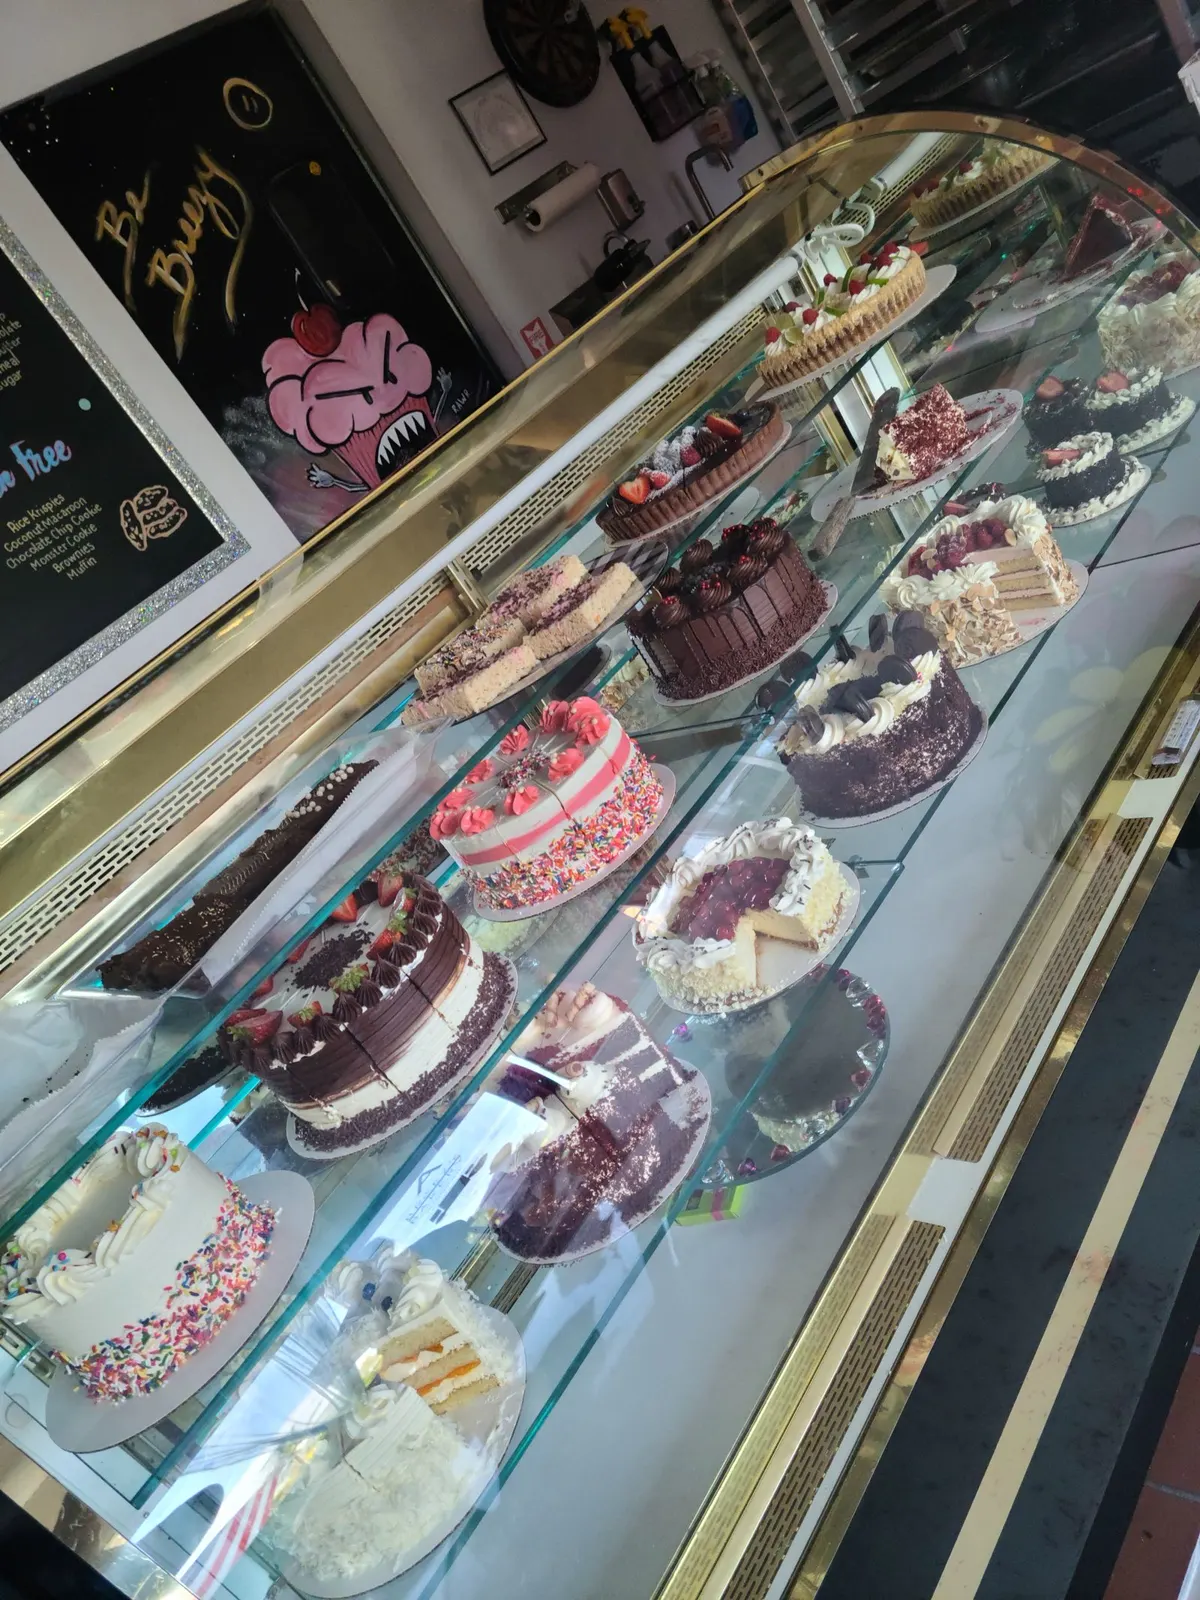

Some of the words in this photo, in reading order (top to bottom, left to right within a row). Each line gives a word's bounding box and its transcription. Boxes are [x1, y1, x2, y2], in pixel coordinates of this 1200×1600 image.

[95, 169, 150, 312] Be
[145, 146, 254, 364] Breezy
[0, 321, 22, 338] olate
[0, 337, 21, 355] utter
[9, 440, 72, 482] Free
[4, 523, 45, 552] Coconut
[41, 497, 88, 529] Macaroon
[7, 516, 31, 533] Rice
[27, 494, 65, 520] Krispies
[6, 536, 53, 569] Chocolate
[50, 523, 73, 540] Chip
[70, 503, 102, 526] Cookie
[30, 542, 68, 571] Monster
[65, 523, 98, 547] Cookie
[52, 542, 96, 573] Brownies
[66, 557, 97, 580] Muffin
